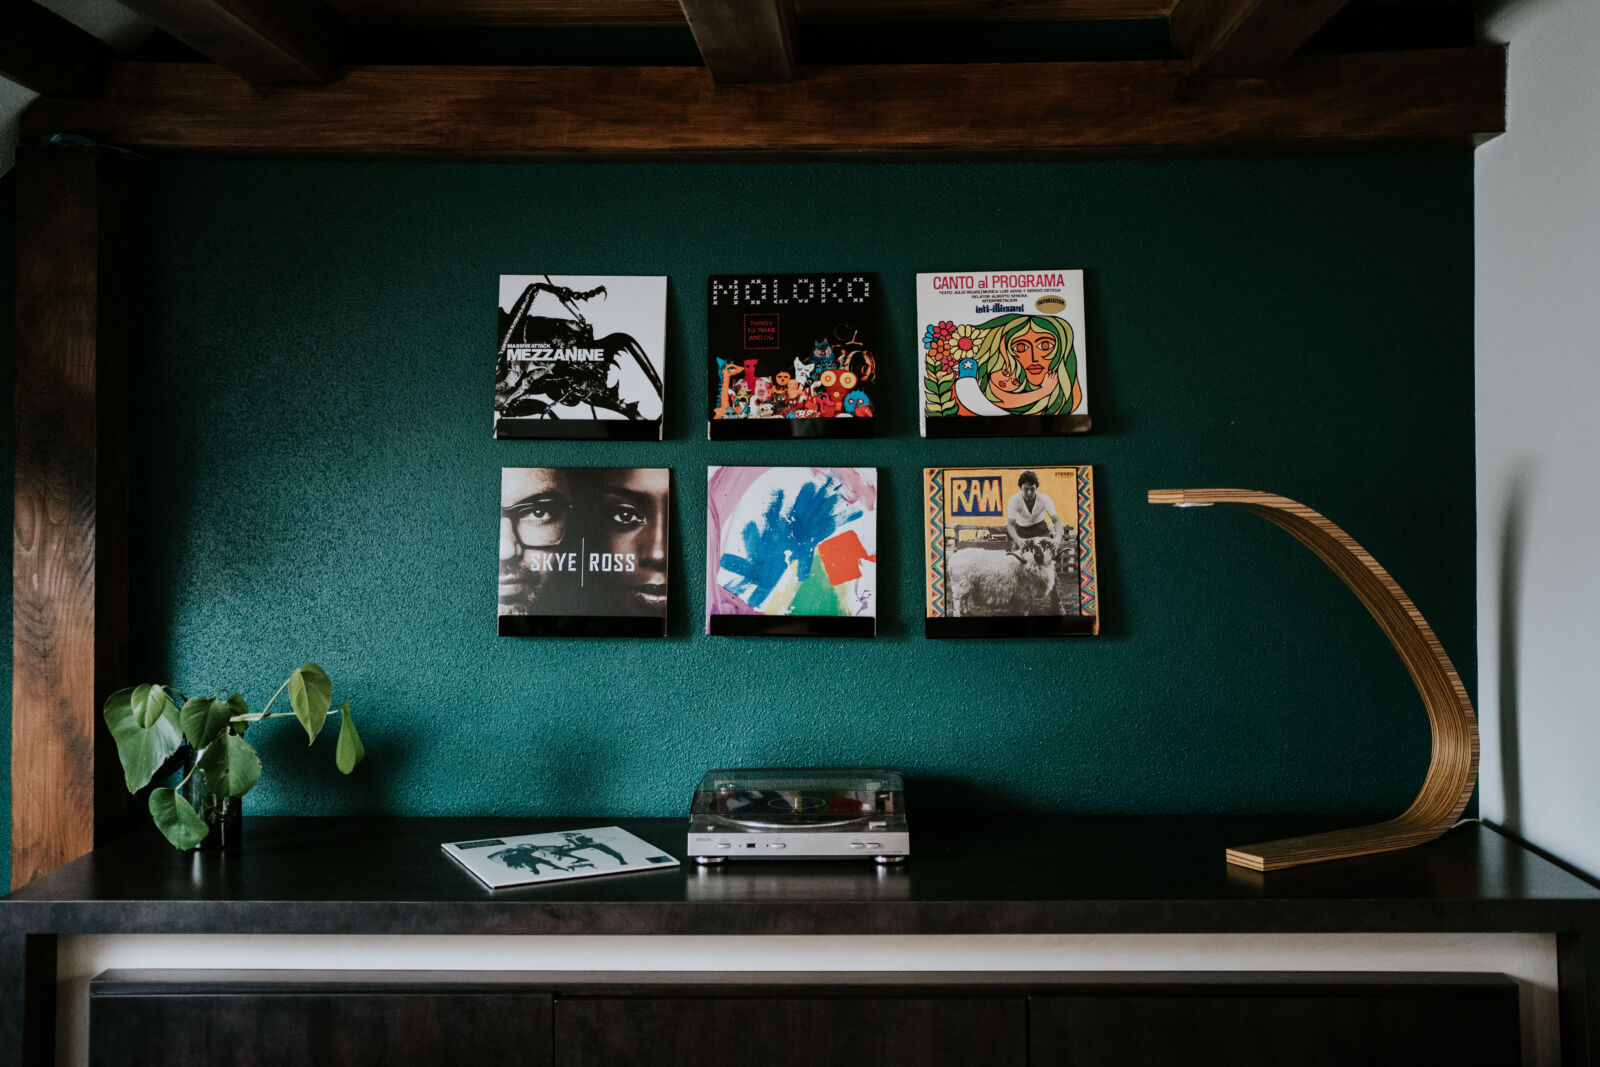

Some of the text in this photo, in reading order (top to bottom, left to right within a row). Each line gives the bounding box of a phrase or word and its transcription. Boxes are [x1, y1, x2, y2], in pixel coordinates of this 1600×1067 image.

[712, 277, 870, 306] MOLOKO
[933, 273, 1065, 290] CANTO al PROGRAMA
[506, 348, 605, 361] MEZZANINE
[952, 479, 1003, 513] RAM
[530, 552, 635, 572] SKYE ROSS
